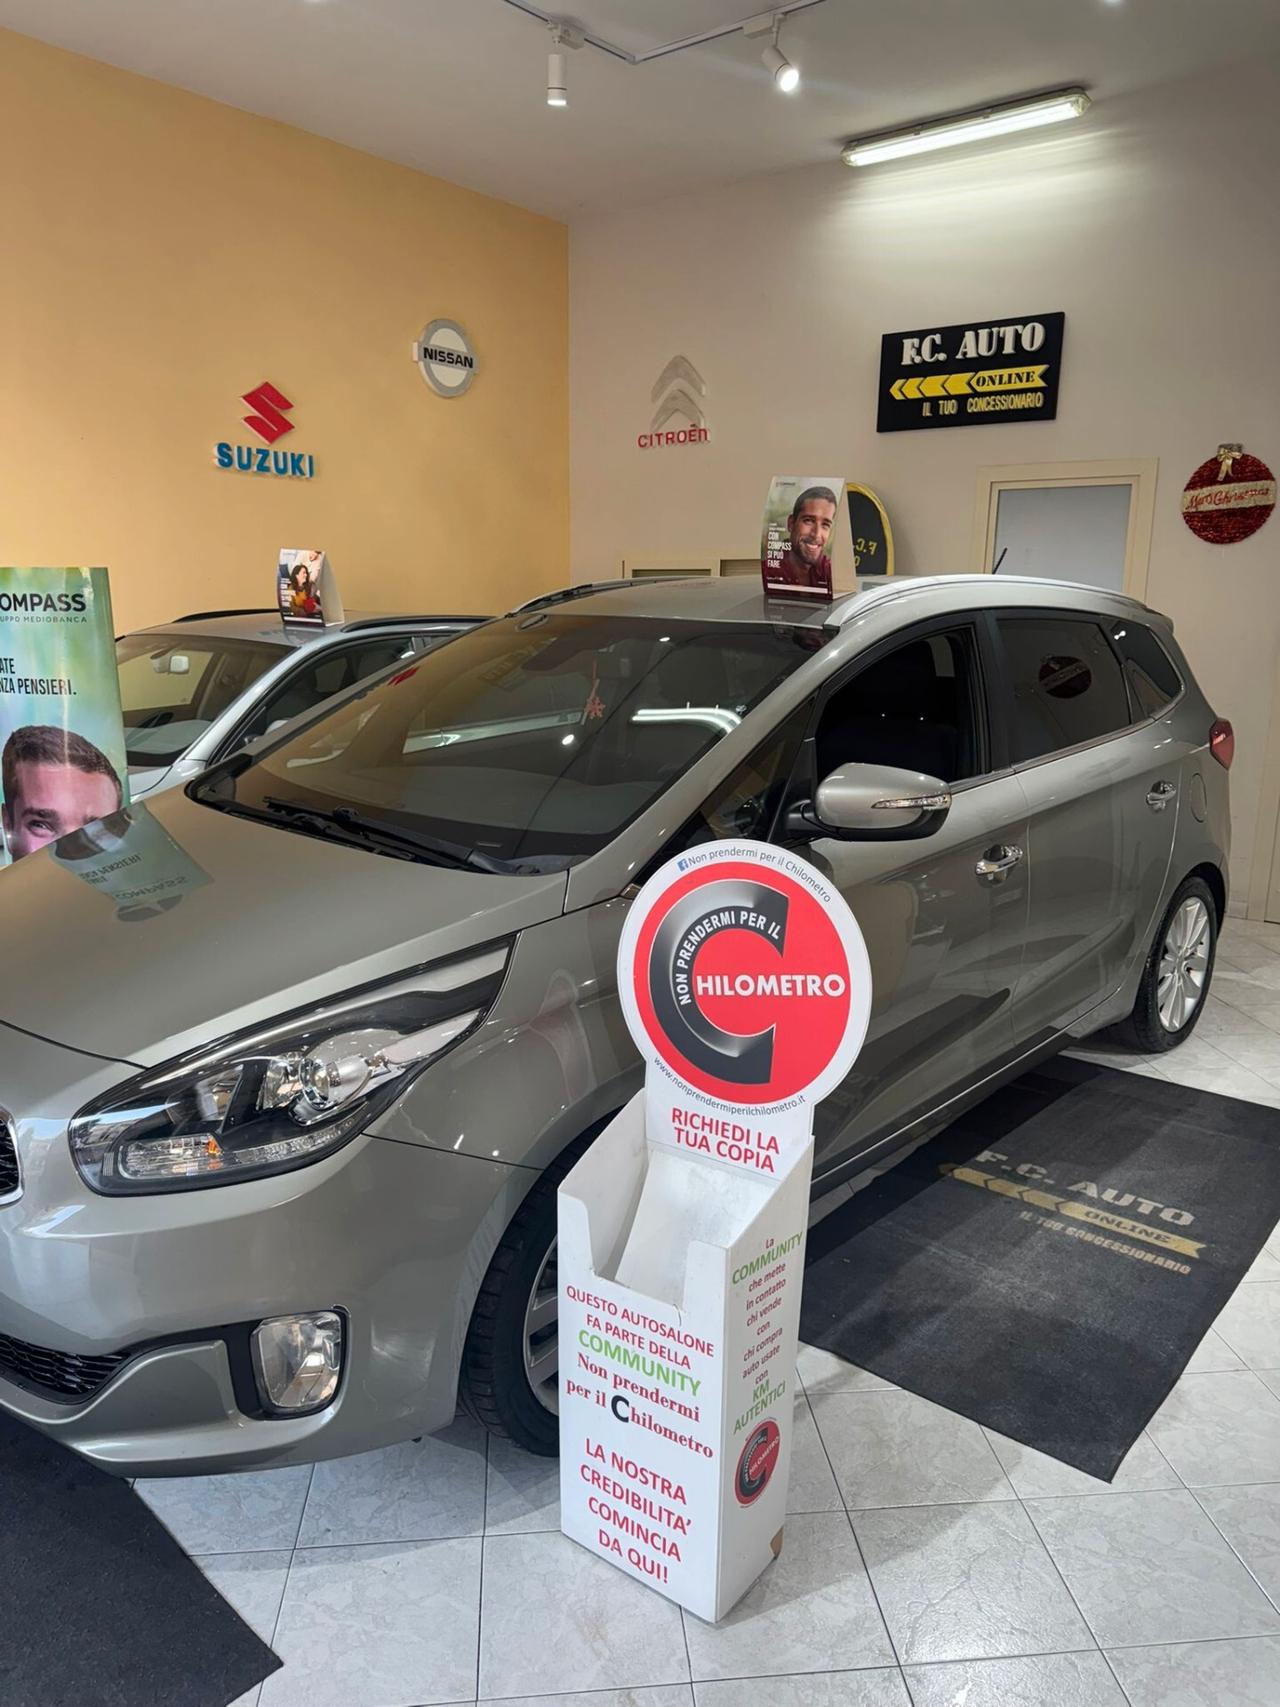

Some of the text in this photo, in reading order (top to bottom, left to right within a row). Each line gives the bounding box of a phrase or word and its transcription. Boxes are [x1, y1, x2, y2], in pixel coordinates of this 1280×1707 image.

[423, 347, 474, 369] NISSAN
[901, 322, 1046, 366] F.C. AUTO
[975, 371, 1036, 388] ONLINE
[922, 392, 1043, 417] IL TUO CONCESSIONARIO
[215, 442, 315, 478] SUZUKI
[17, 678, 77, 696] PENSIERI.
[688, 847, 831, 903] Non prendermi per il Chilometro
[676, 911, 782, 1006] NON PRENDERMI PER IL
[654, 1057, 806, 1116] www.nonprendermiperilchilometro.it
[672, 1107, 780, 1155] RICHIEDI LA
[674, 1127, 775, 1173] TUA COPIA
[973, 1150, 1196, 1226] F.C. AUTO
[765, 1237, 775, 1249] La
[1019, 1211, 1193, 1275] IL TUO CONCESSIONARIO
[1084, 1209, 1172, 1244] ONLINE
[732, 1231, 803, 1285] COMMUNITY
[748, 1262, 786, 1292] che mette
[746, 1278, 787, 1311] in contatto
[746, 1297, 782, 1327] chi vende
[566, 1285, 714, 1357] QUESTO AUTOSALONE
[586, 1313, 691, 1370] FA PARTE DELLA
[743, 1326, 783, 1362] chi compra
[756, 1321, 770, 1336] con
[578, 1329, 701, 1397] COMMUNITY
[742, 1344, 781, 1379] auto usate
[755, 1369, 769, 1385] con
[577, 1352, 700, 1422] Non prendermi
[733, 1380, 786, 1435] AUTENTICI
[752, 1379, 770, 1402] KM
[566, 1379, 714, 1458] per il Chilometro
[586, 1438, 687, 1505] LA NOSTRA
[580, 1464, 692, 1535] CREDIBILITA'
[588, 1496, 681, 1562] COMINCIA
[599, 1529, 668, 1583] DA QUI!
